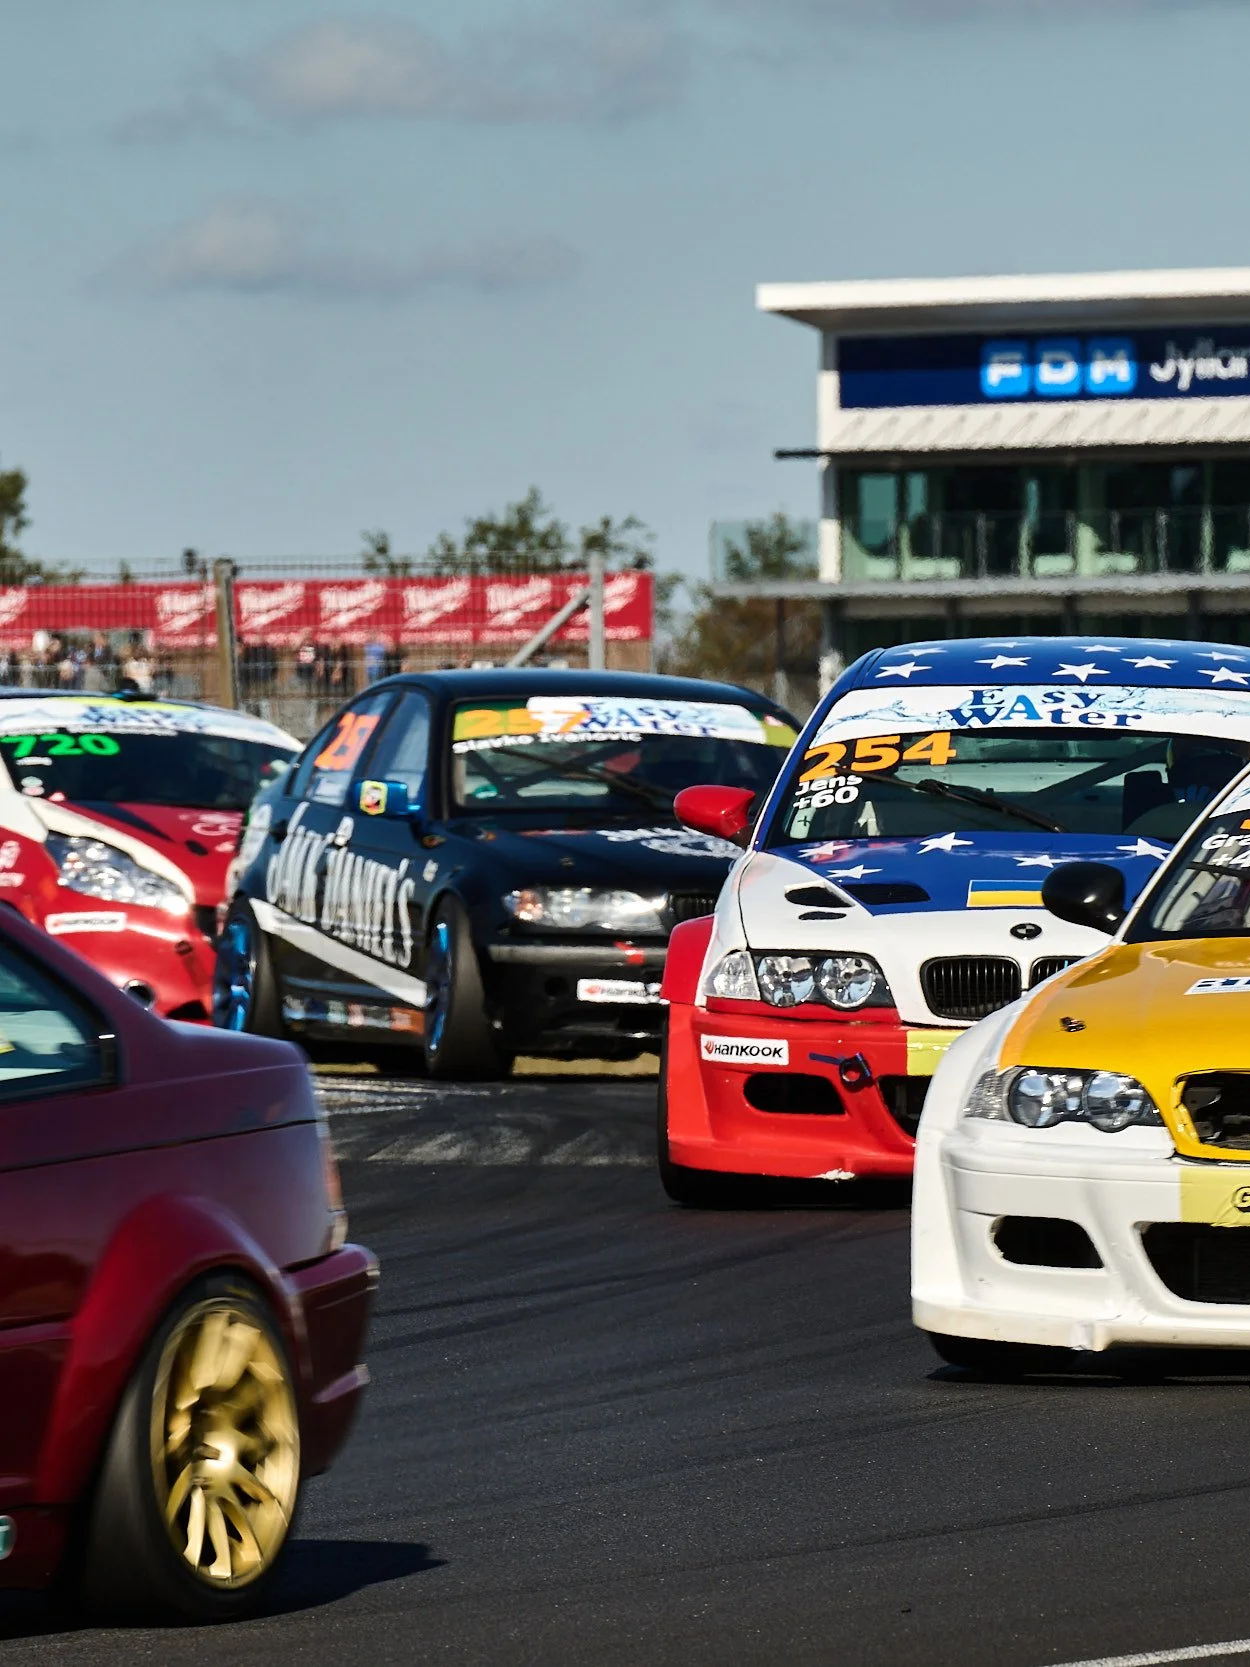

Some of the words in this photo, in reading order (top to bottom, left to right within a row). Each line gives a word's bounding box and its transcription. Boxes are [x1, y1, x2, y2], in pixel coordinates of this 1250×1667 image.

[985, 348, 1133, 388] FDM
[461, 707, 593, 737] 257
[0, 732, 121, 760] 720
[800, 732, 957, 782] 254
[793, 786, 860, 809] +60
[795, 774, 863, 796] Jens
